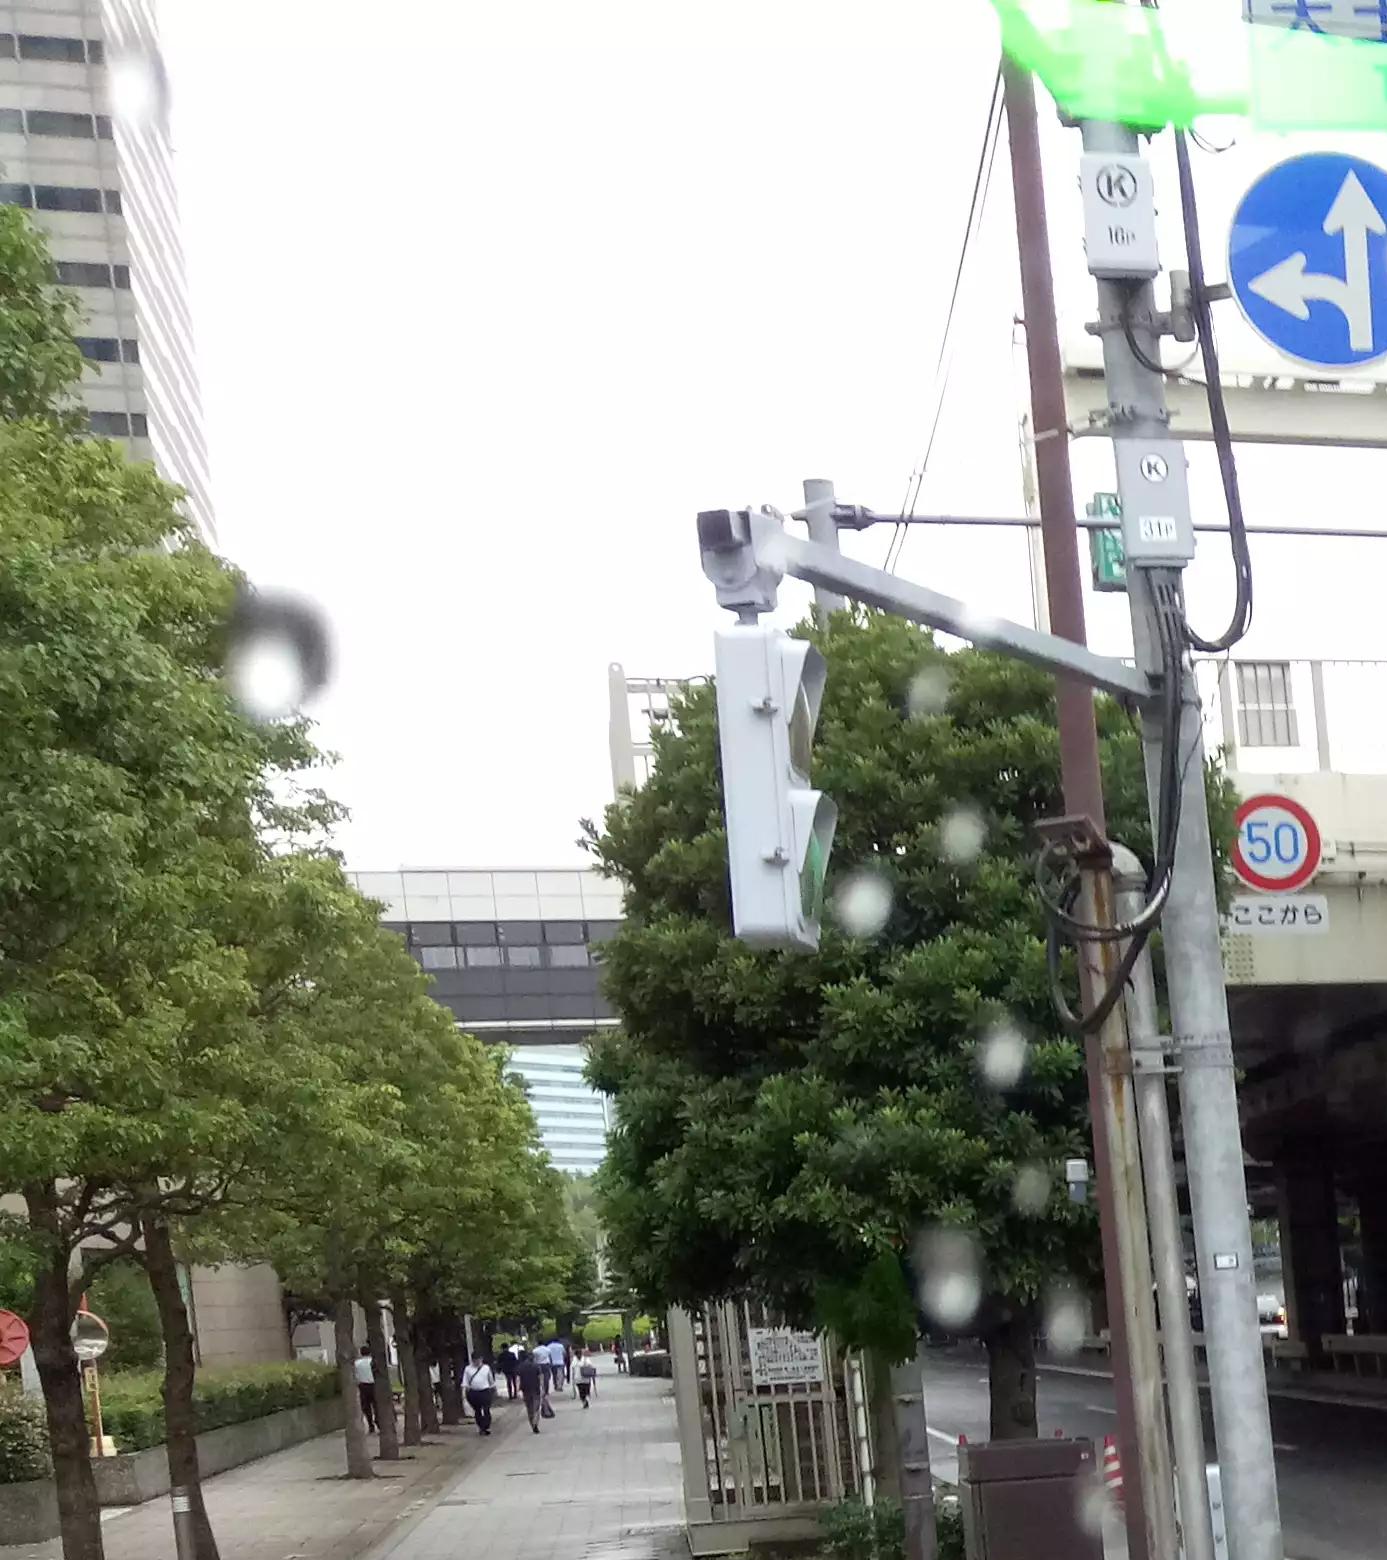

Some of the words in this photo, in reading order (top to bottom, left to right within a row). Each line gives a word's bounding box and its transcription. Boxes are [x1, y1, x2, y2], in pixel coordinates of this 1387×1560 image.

[1246, 821, 1299, 865] 50
[1234, 903, 1322, 926] ここから
